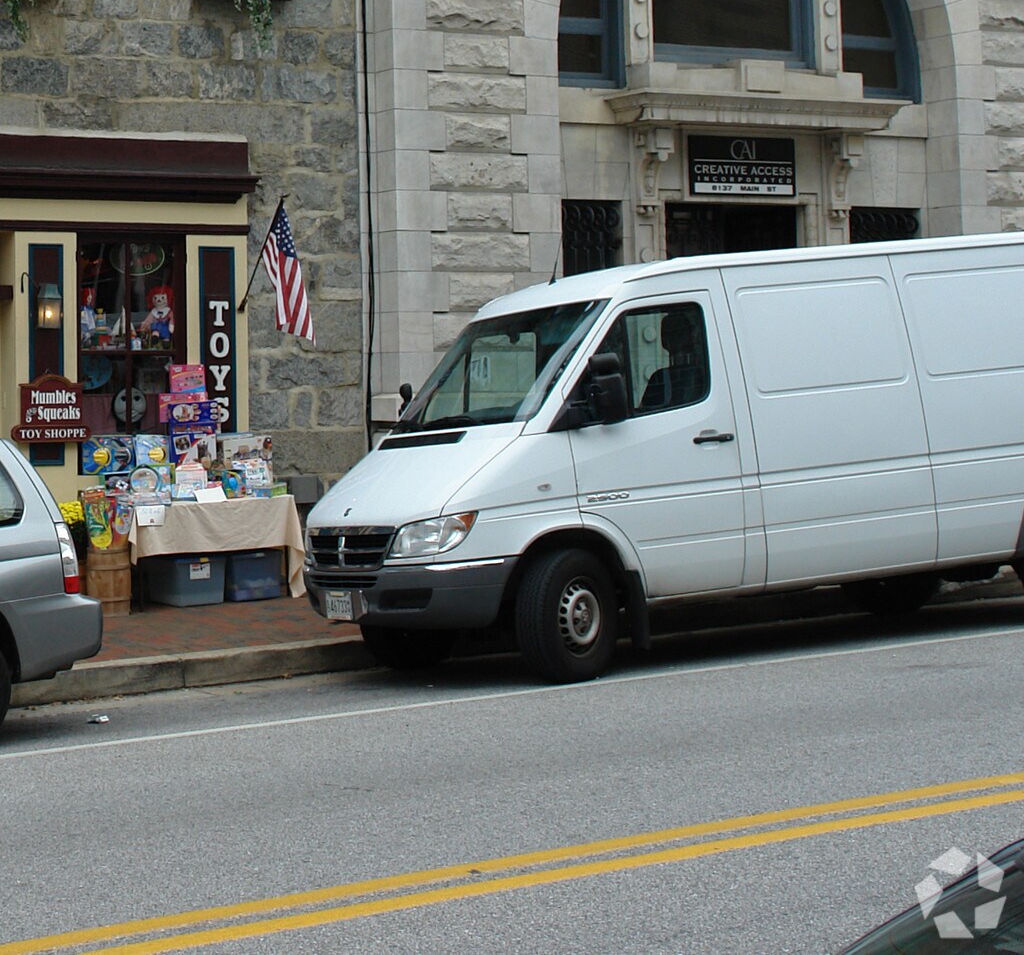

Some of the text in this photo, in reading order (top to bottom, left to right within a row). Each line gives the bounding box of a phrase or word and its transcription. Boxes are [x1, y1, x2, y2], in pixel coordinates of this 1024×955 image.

[730, 139, 756, 160] CAI
[694, 164, 793, 176] CREATIVE ACCESS
[697, 176, 792, 184] INCORPORATED
[208, 300, 231, 423] TOYS
[31, 390, 76, 405] Mumbles
[37, 406, 81, 422] Squeaks
[19, 428, 87, 439] TOY SHOPPE
[587, 491, 629, 503] 2500
